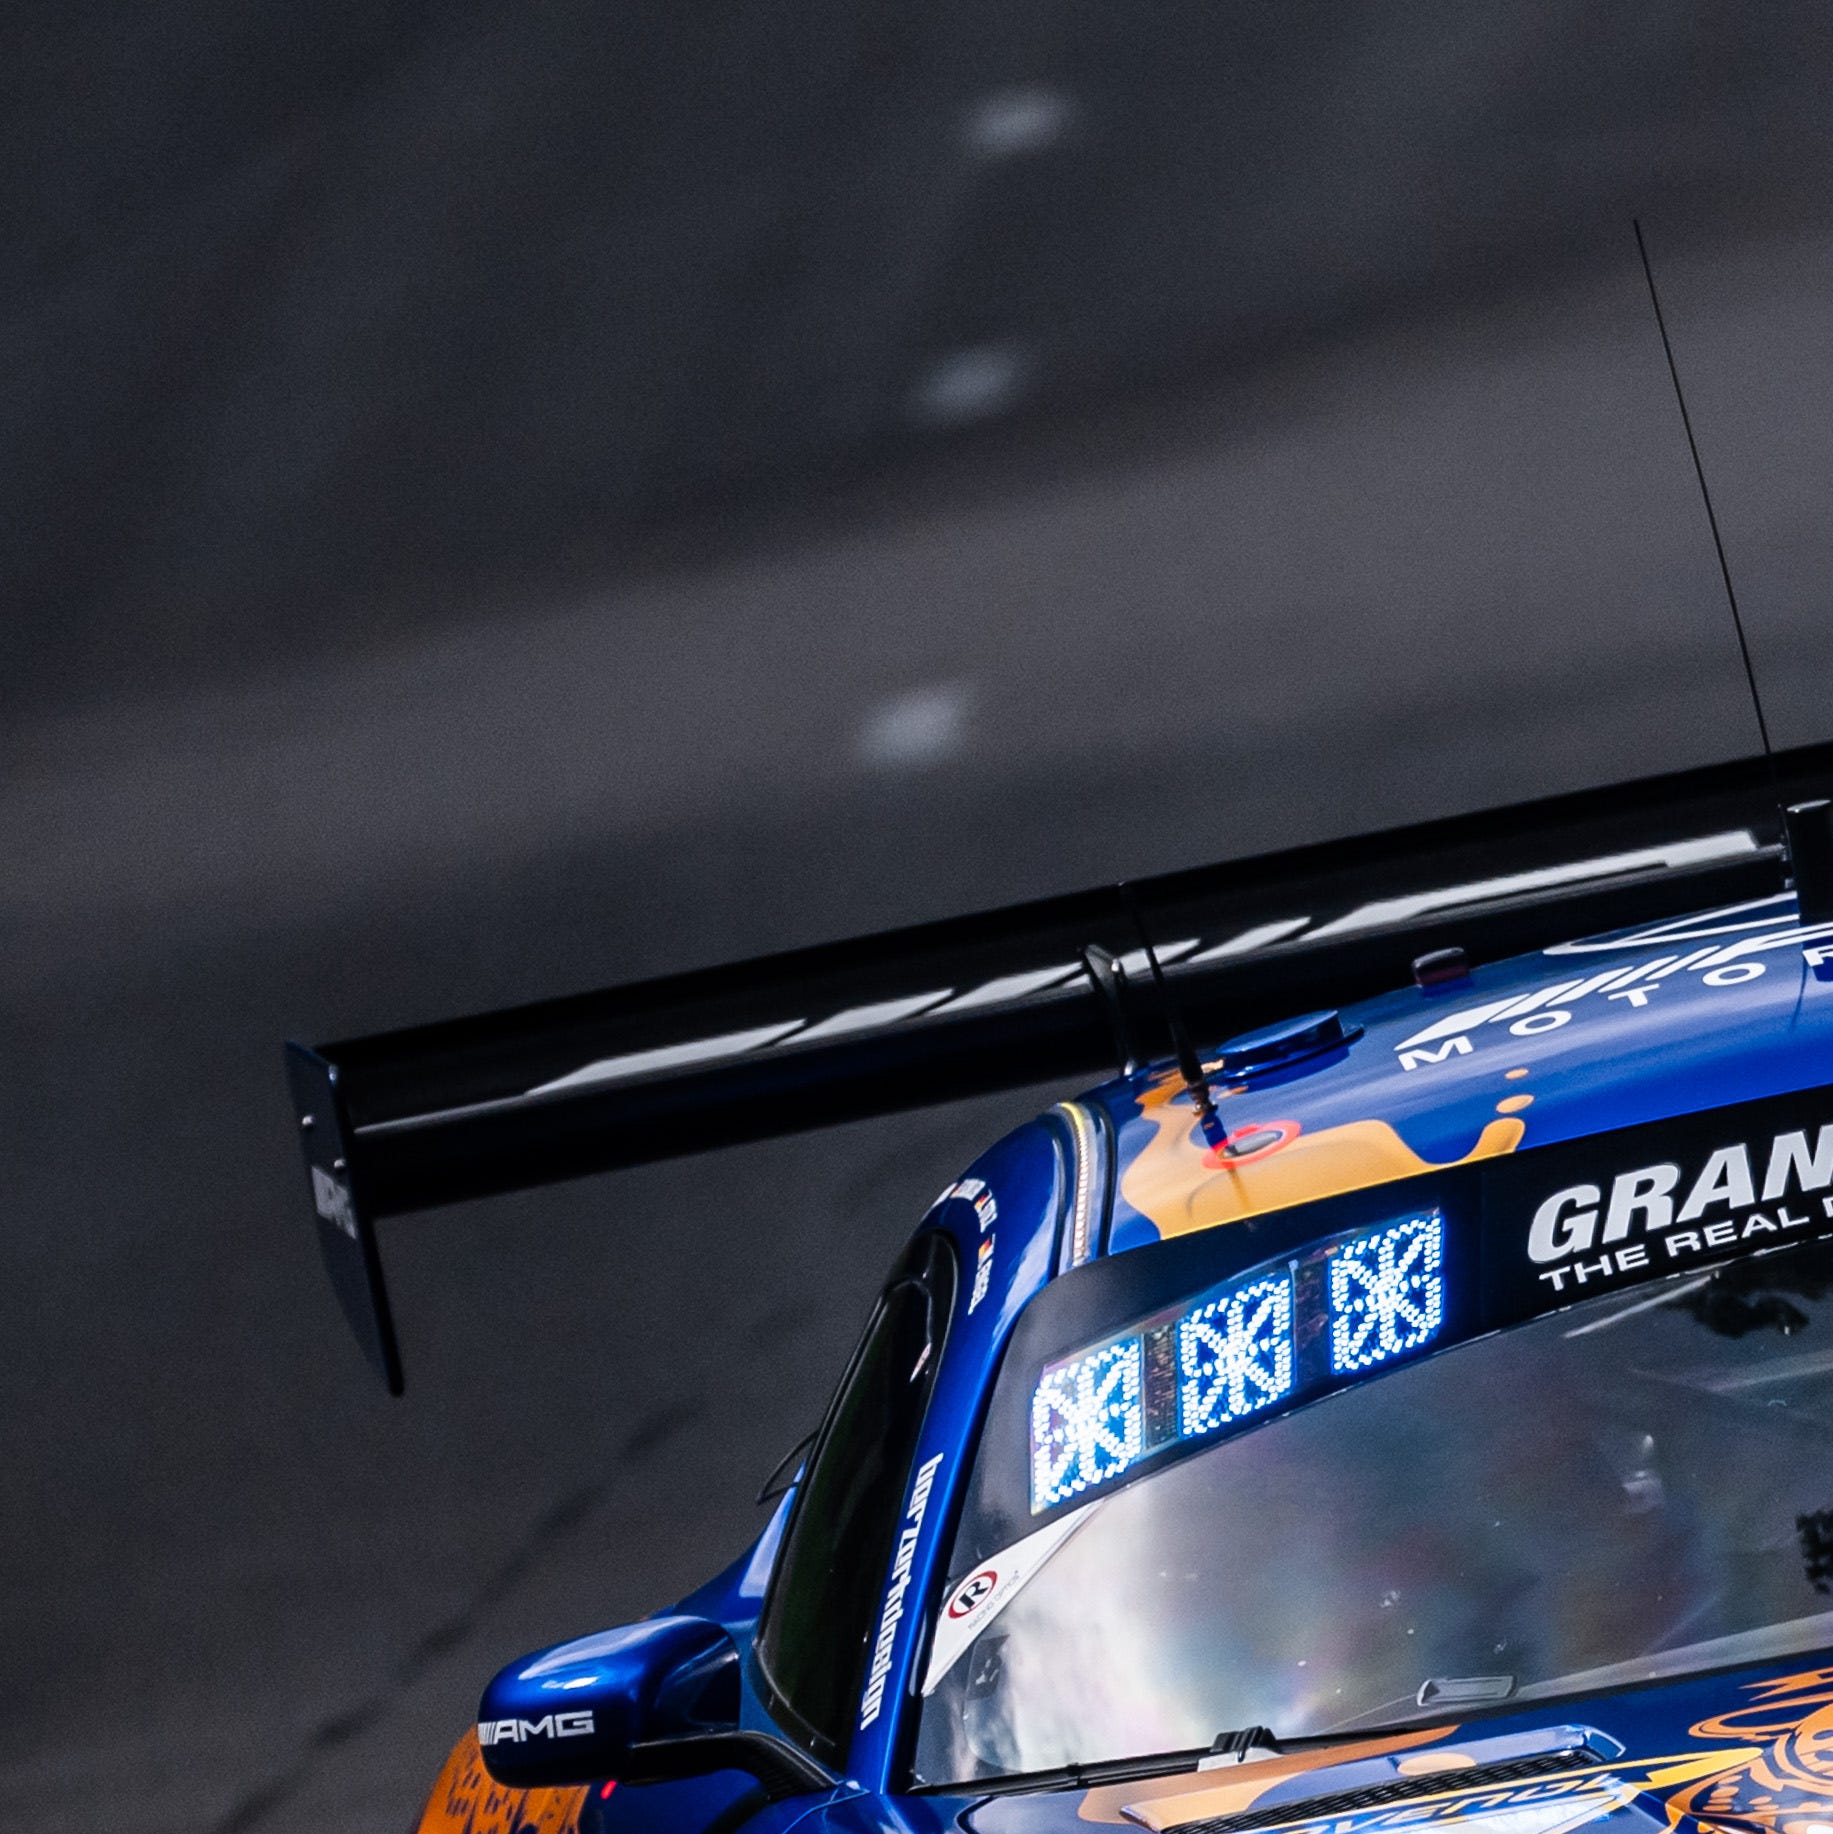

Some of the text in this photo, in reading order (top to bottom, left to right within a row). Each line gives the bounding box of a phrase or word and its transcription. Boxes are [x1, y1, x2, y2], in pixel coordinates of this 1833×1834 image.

[1538, 1247, 1644, 1292] THE
[1653, 1212, 1812, 1267] REAL
[493, 1710, 595, 1745] AMG
